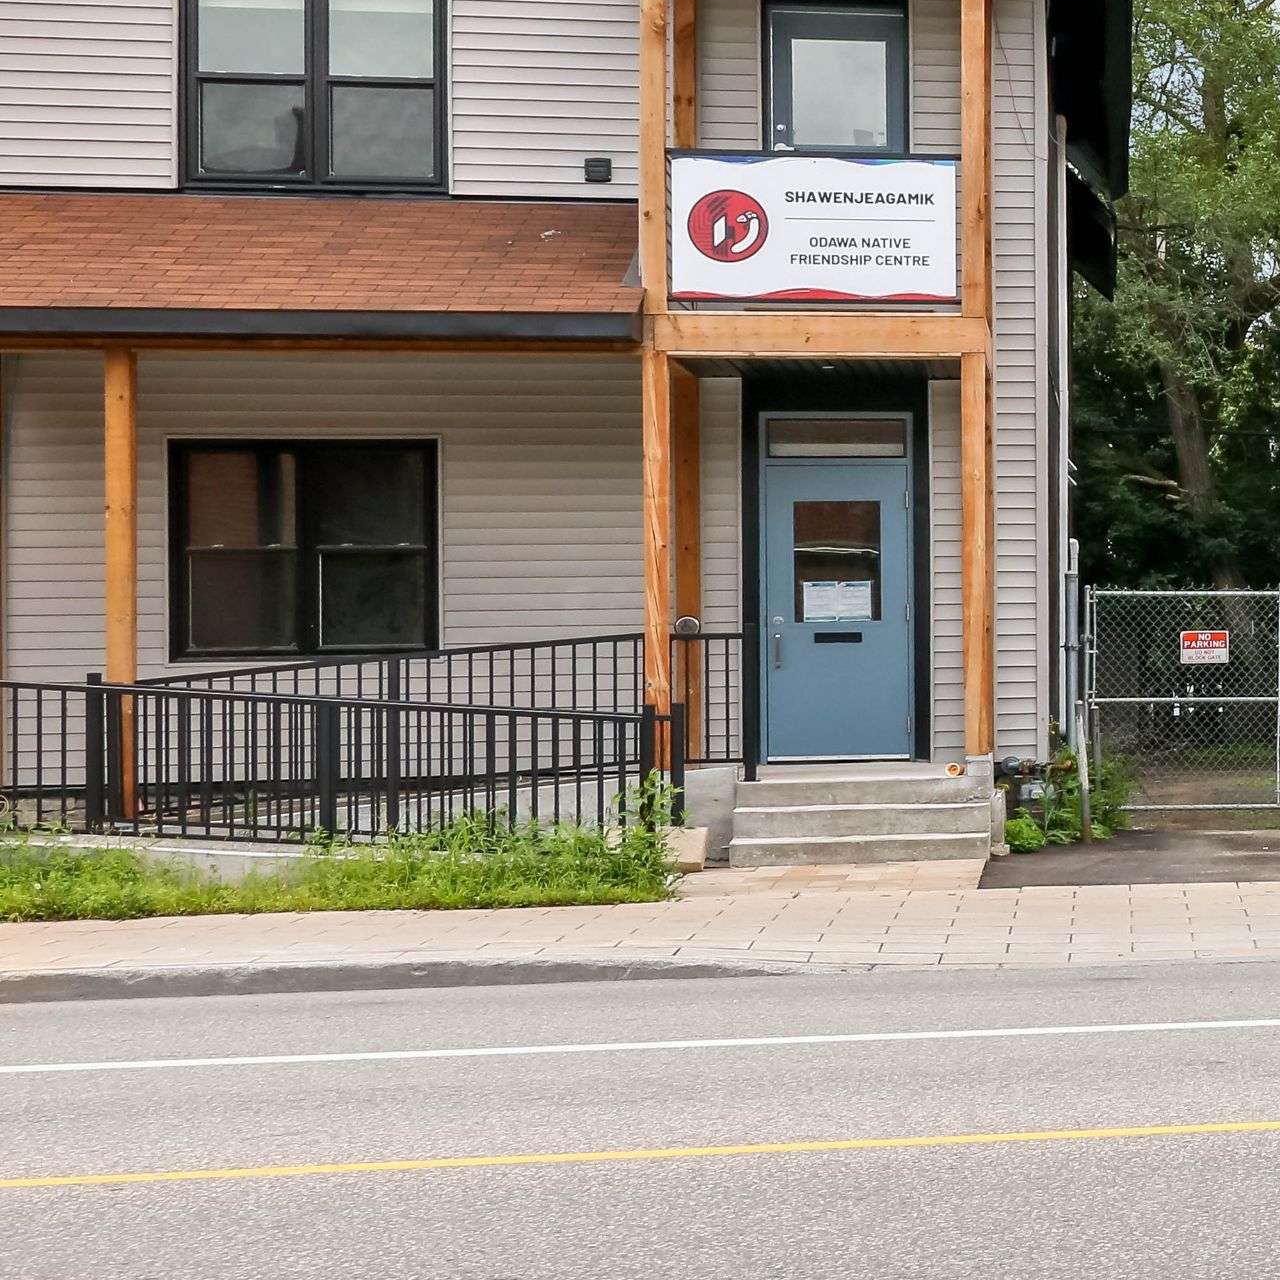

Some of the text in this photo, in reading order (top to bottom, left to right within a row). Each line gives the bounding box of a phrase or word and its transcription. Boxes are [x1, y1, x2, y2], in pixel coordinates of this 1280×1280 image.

[784, 191, 935, 205] SHAWENJEAGAMIK
[809, 236, 911, 249] ODAWA NATIVE
[790, 253, 930, 267] FRIENDSHIP CENTRE
[1198, 633, 1212, 641] NO
[1184, 640, 1226, 648] PARKING
